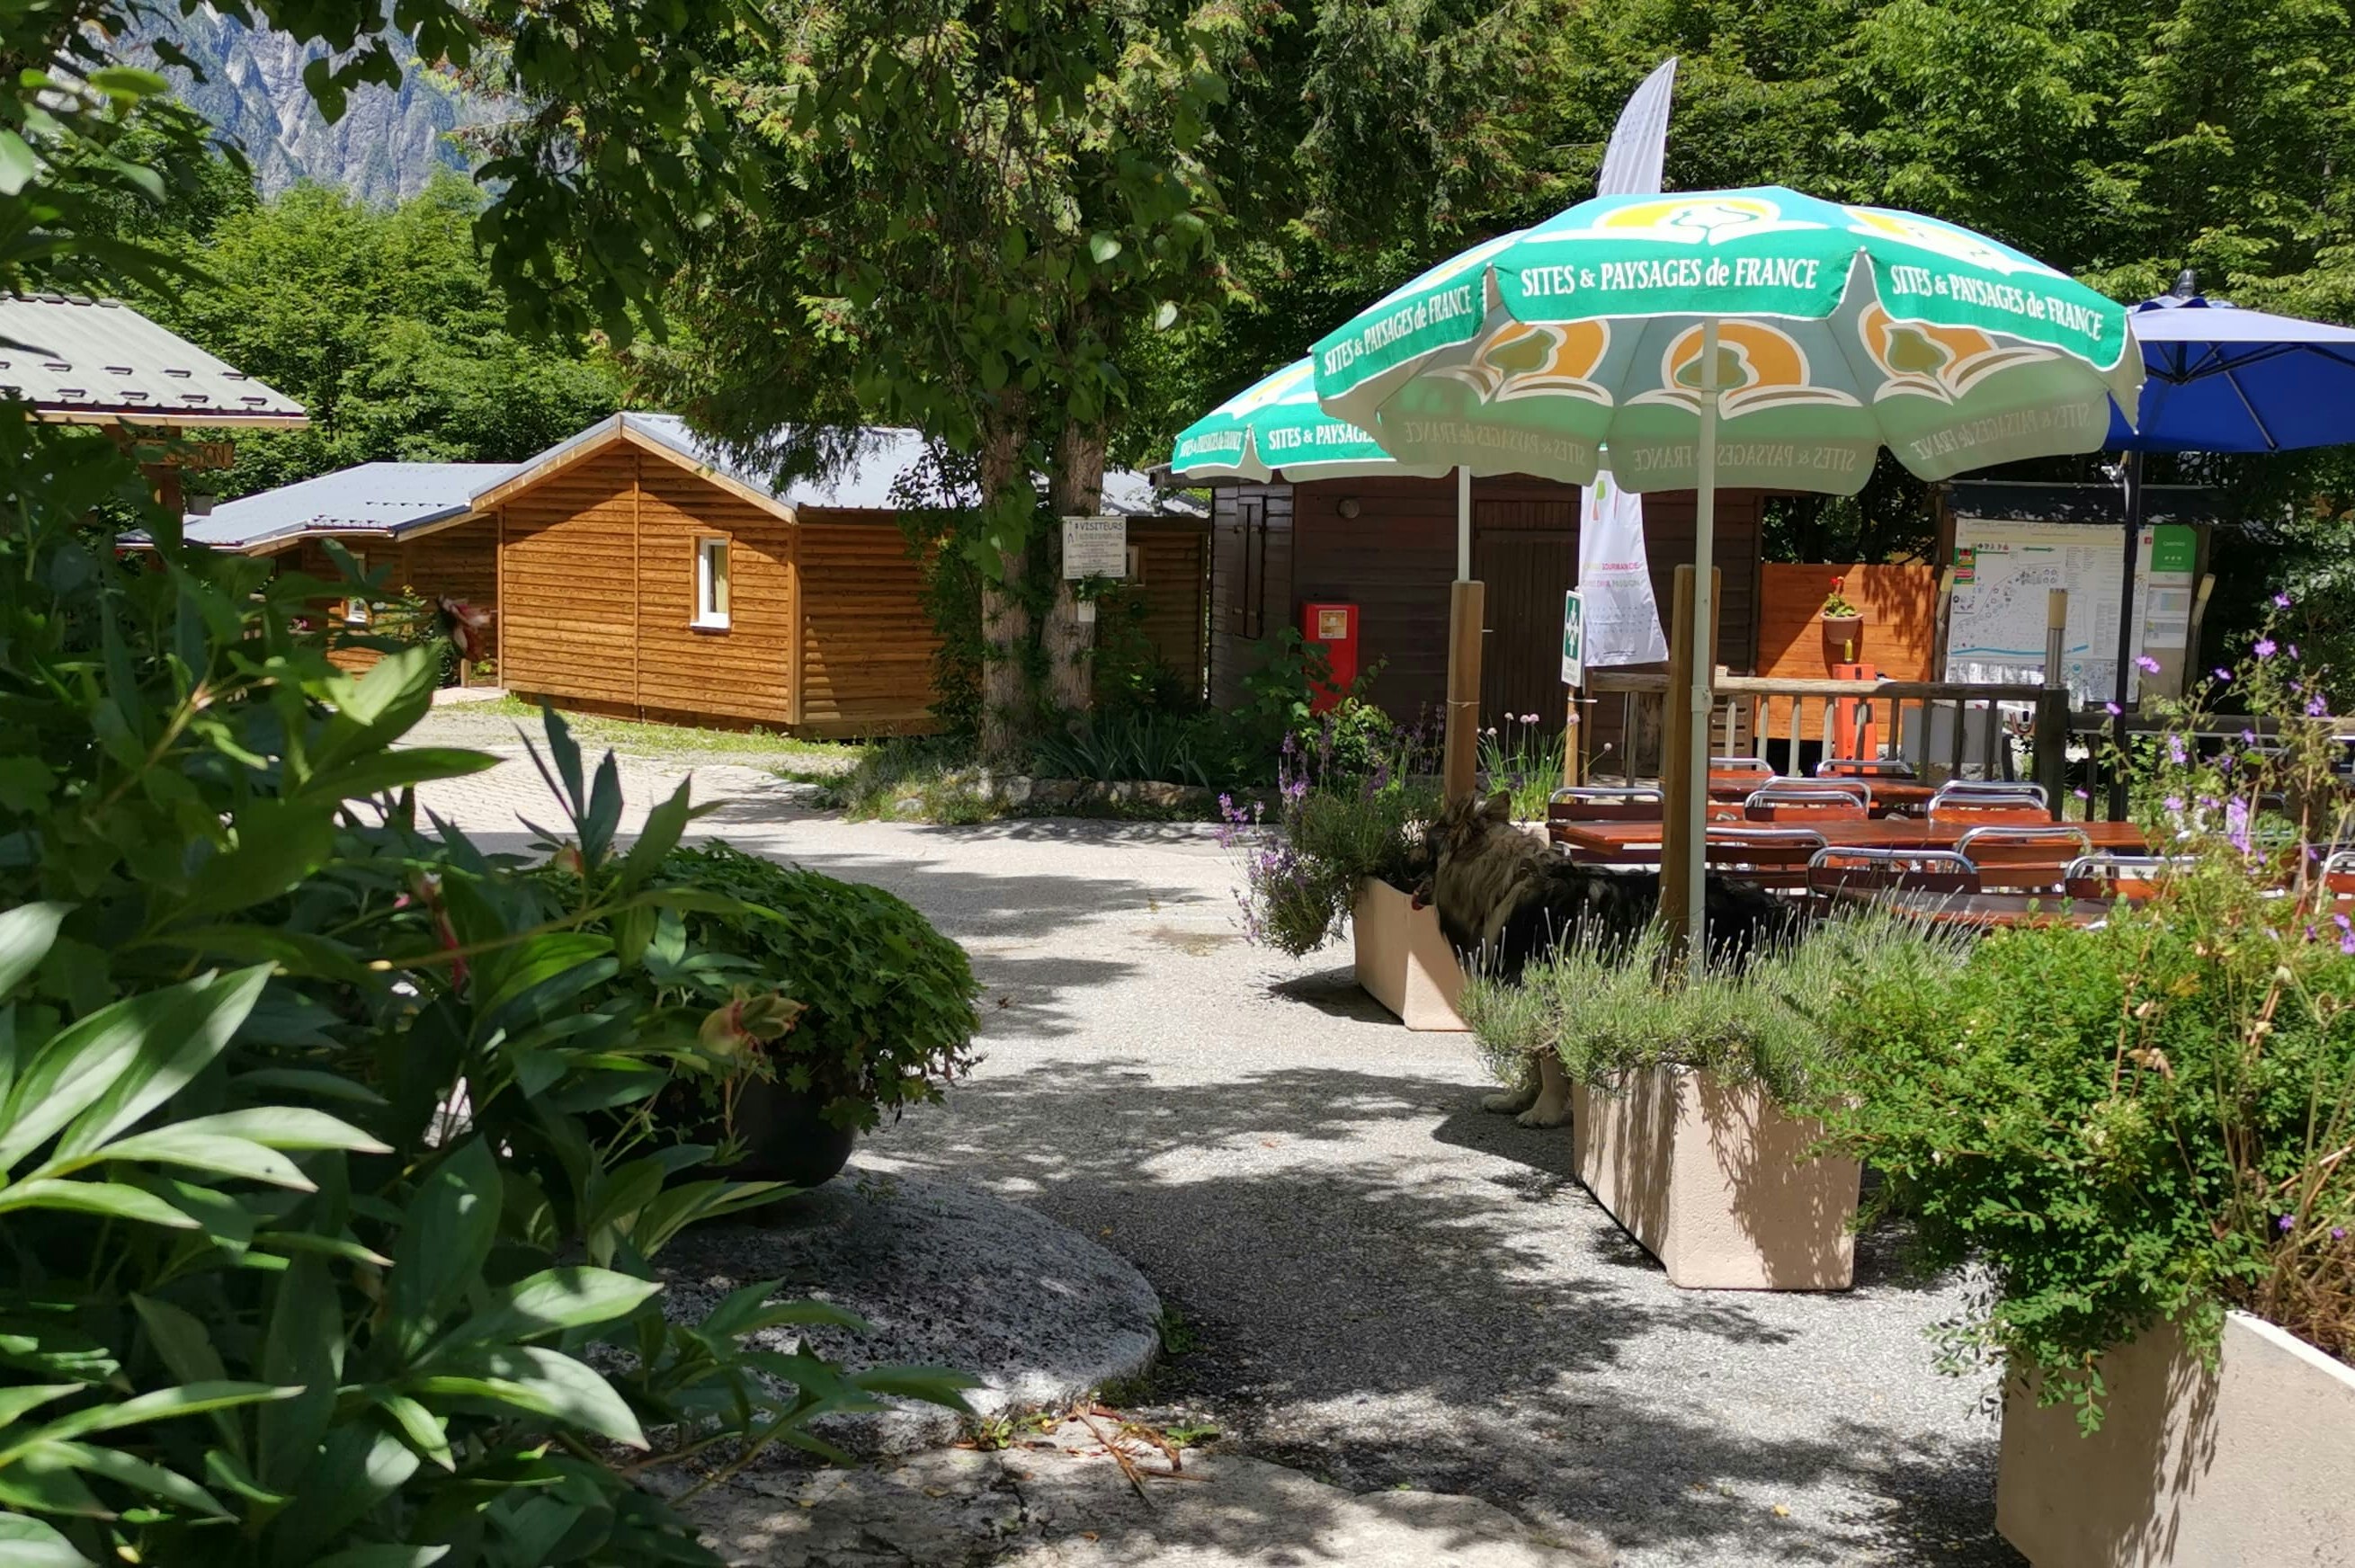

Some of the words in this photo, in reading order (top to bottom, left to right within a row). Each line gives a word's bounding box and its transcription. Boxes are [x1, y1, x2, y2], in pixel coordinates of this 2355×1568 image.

[1521, 264, 1574, 297] SITES
[1580, 268, 1595, 289] &
[1601, 258, 1701, 290] PAYSAGES
[1706, 257, 1729, 286] de
[1734, 258, 1819, 290] FRANCE
[1890, 265, 1933, 297] SITES
[1934, 275, 1949, 295] &
[1947, 272, 2024, 314] PAYSAGES
[2026, 290, 2046, 320] de
[2045, 297, 2104, 342] FRANCE
[1324, 338, 1354, 377] SITES
[1354, 337, 1364, 357] &
[1363, 306, 1414, 355] PAYSAGES
[1414, 301, 1428, 329] de
[1429, 285, 1473, 325] FRANCE
[1268, 427, 1301, 450] SITES
[1304, 430, 1314, 443] &
[1316, 423, 1375, 445] PAYSAG
